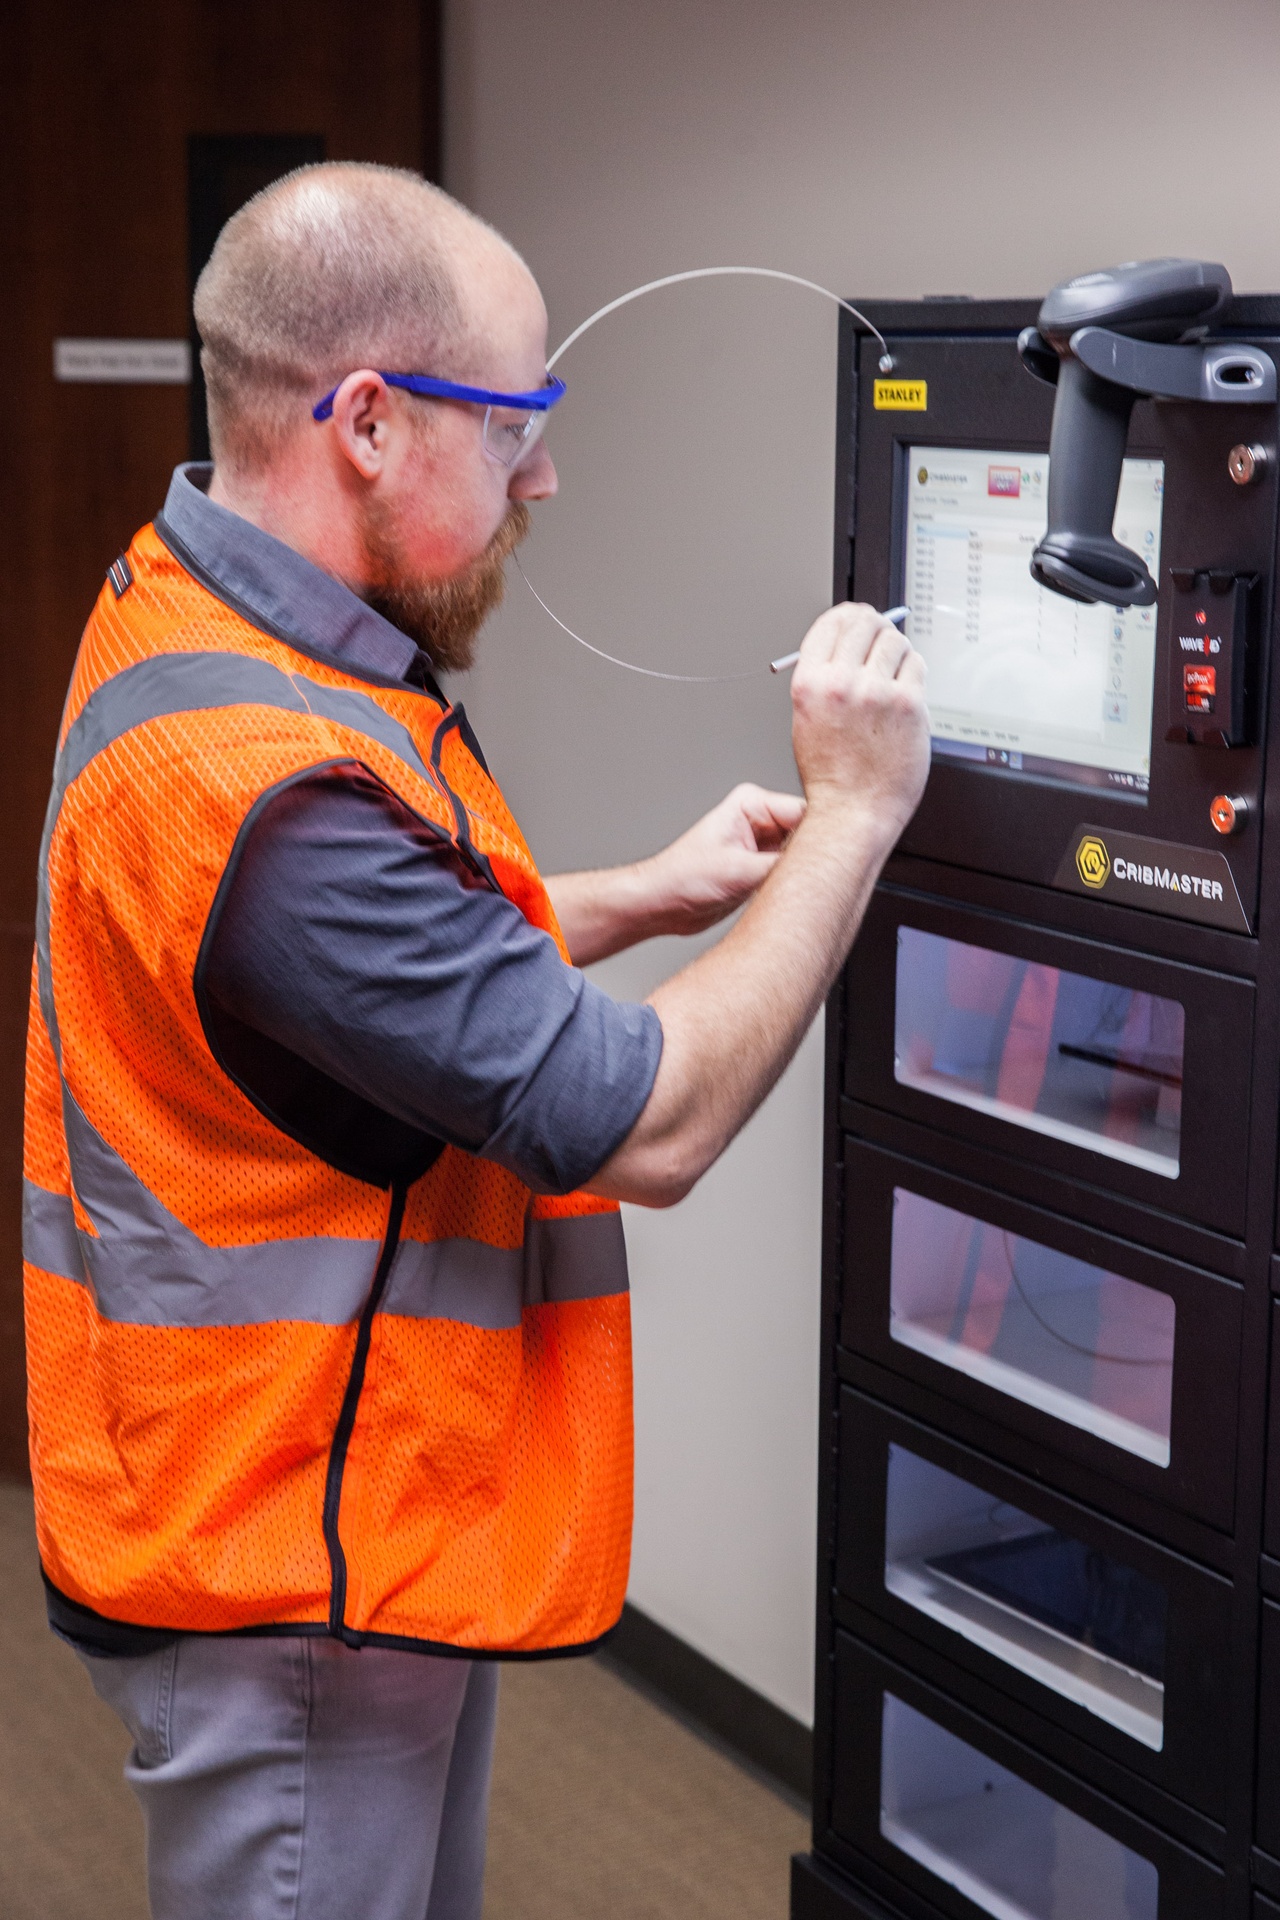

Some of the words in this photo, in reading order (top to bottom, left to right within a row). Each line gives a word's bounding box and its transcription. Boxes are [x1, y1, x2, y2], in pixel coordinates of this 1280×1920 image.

[878, 388, 921, 402] STANLEY
[1179, 636, 1204, 652] WAVE
[1113, 857, 1223, 901] CRIBMASTER
